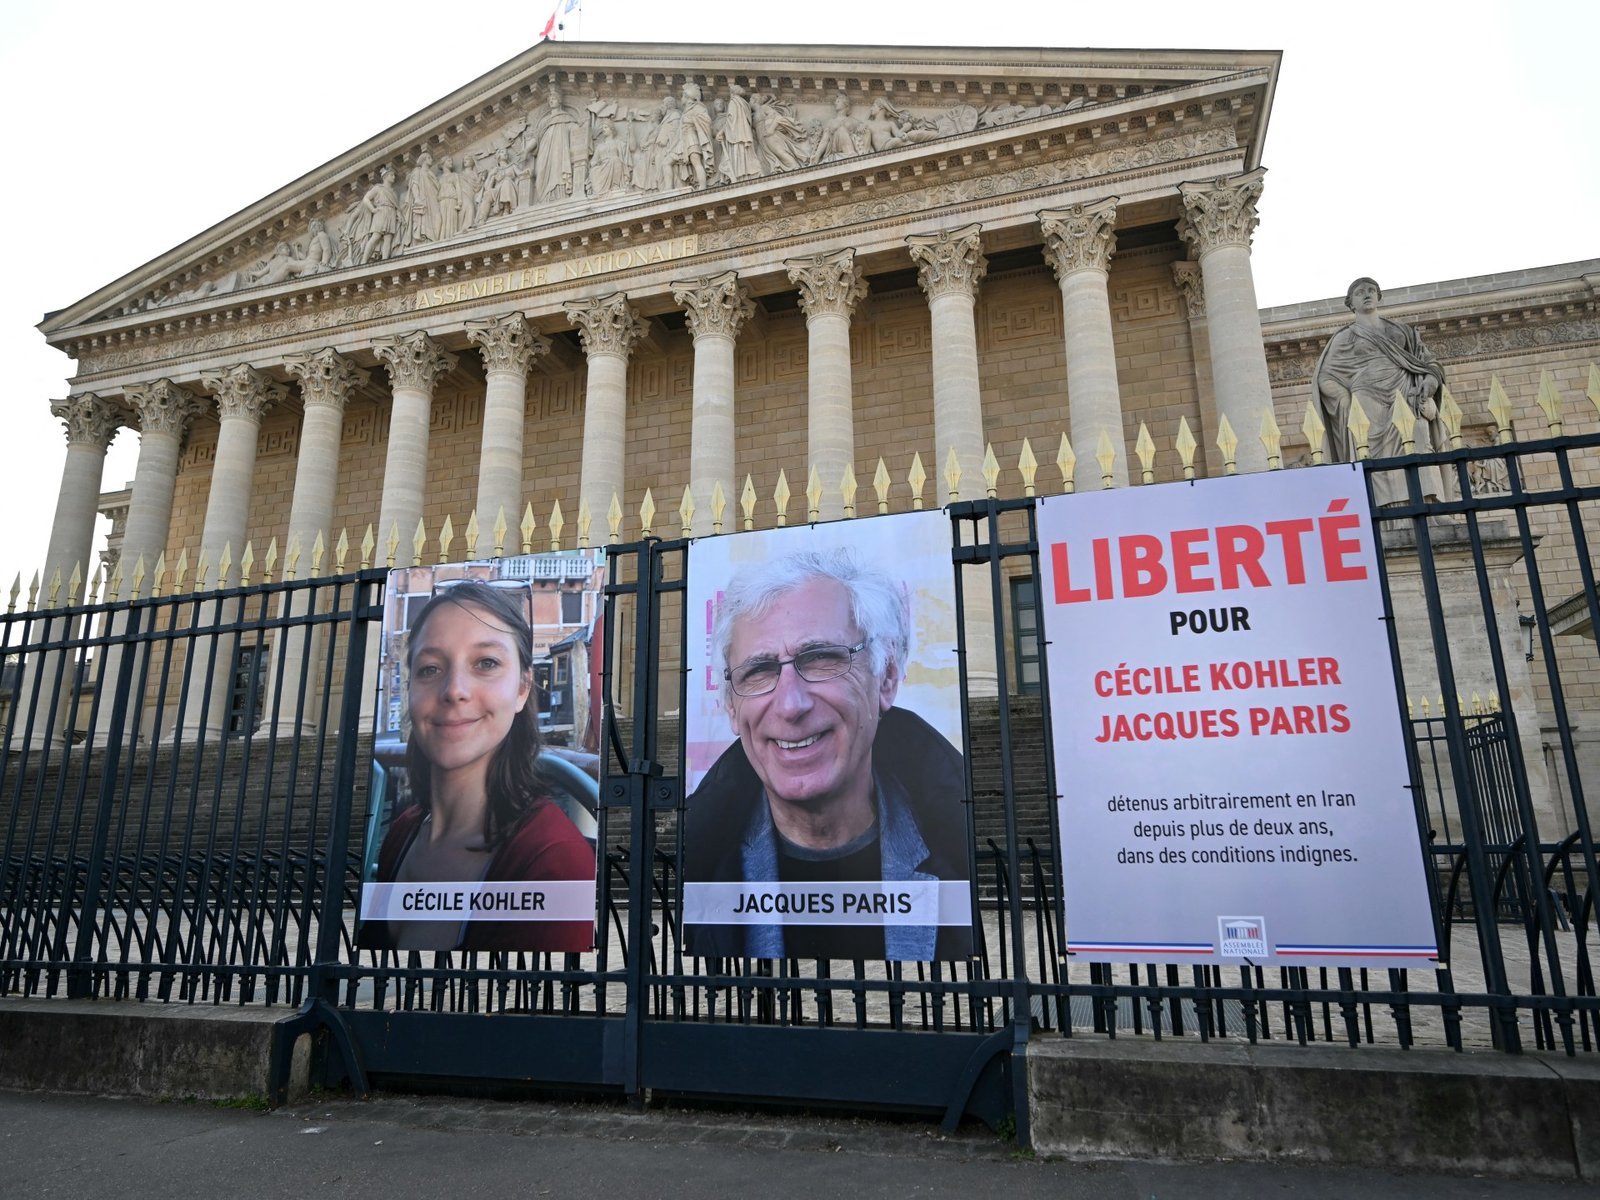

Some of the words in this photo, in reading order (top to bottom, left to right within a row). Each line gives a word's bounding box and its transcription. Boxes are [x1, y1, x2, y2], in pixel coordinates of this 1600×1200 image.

[564, 239, 696, 279] NATIONALE
[1051, 498, 1368, 604] LIBERTÉ
[1170, 607, 1251, 635] POUR
[1094, 663, 1201, 697] CÉCILE
[1210, 657, 1341, 691] KOHLER
[1096, 709, 1240, 743] JACQUES
[1249, 704, 1351, 736] PARIS
[1108, 795, 1168, 811] détenus
[1174, 793, 1291, 810] arbitrairement
[1297, 795, 1316, 807] en
[1322, 790, 1355, 806] Iran
[1134, 821, 1185, 841] depuis
[1191, 820, 1224, 840] plus
[1230, 819, 1248, 835] de
[1254, 819, 1294, 835] deux
[1299, 822, 1333, 836] ans,
[1118, 848, 1154, 863] dans
[1159, 847, 1186, 863] des
[1192, 846, 1275, 863] conditions
[1280, 845, 1357, 866] indignes.
[403, 889, 464, 910] CÉCILE
[470, 892, 545, 910] KOHLER
[733, 893, 834, 914] JACQUES
[843, 893, 911, 913] PARIS
